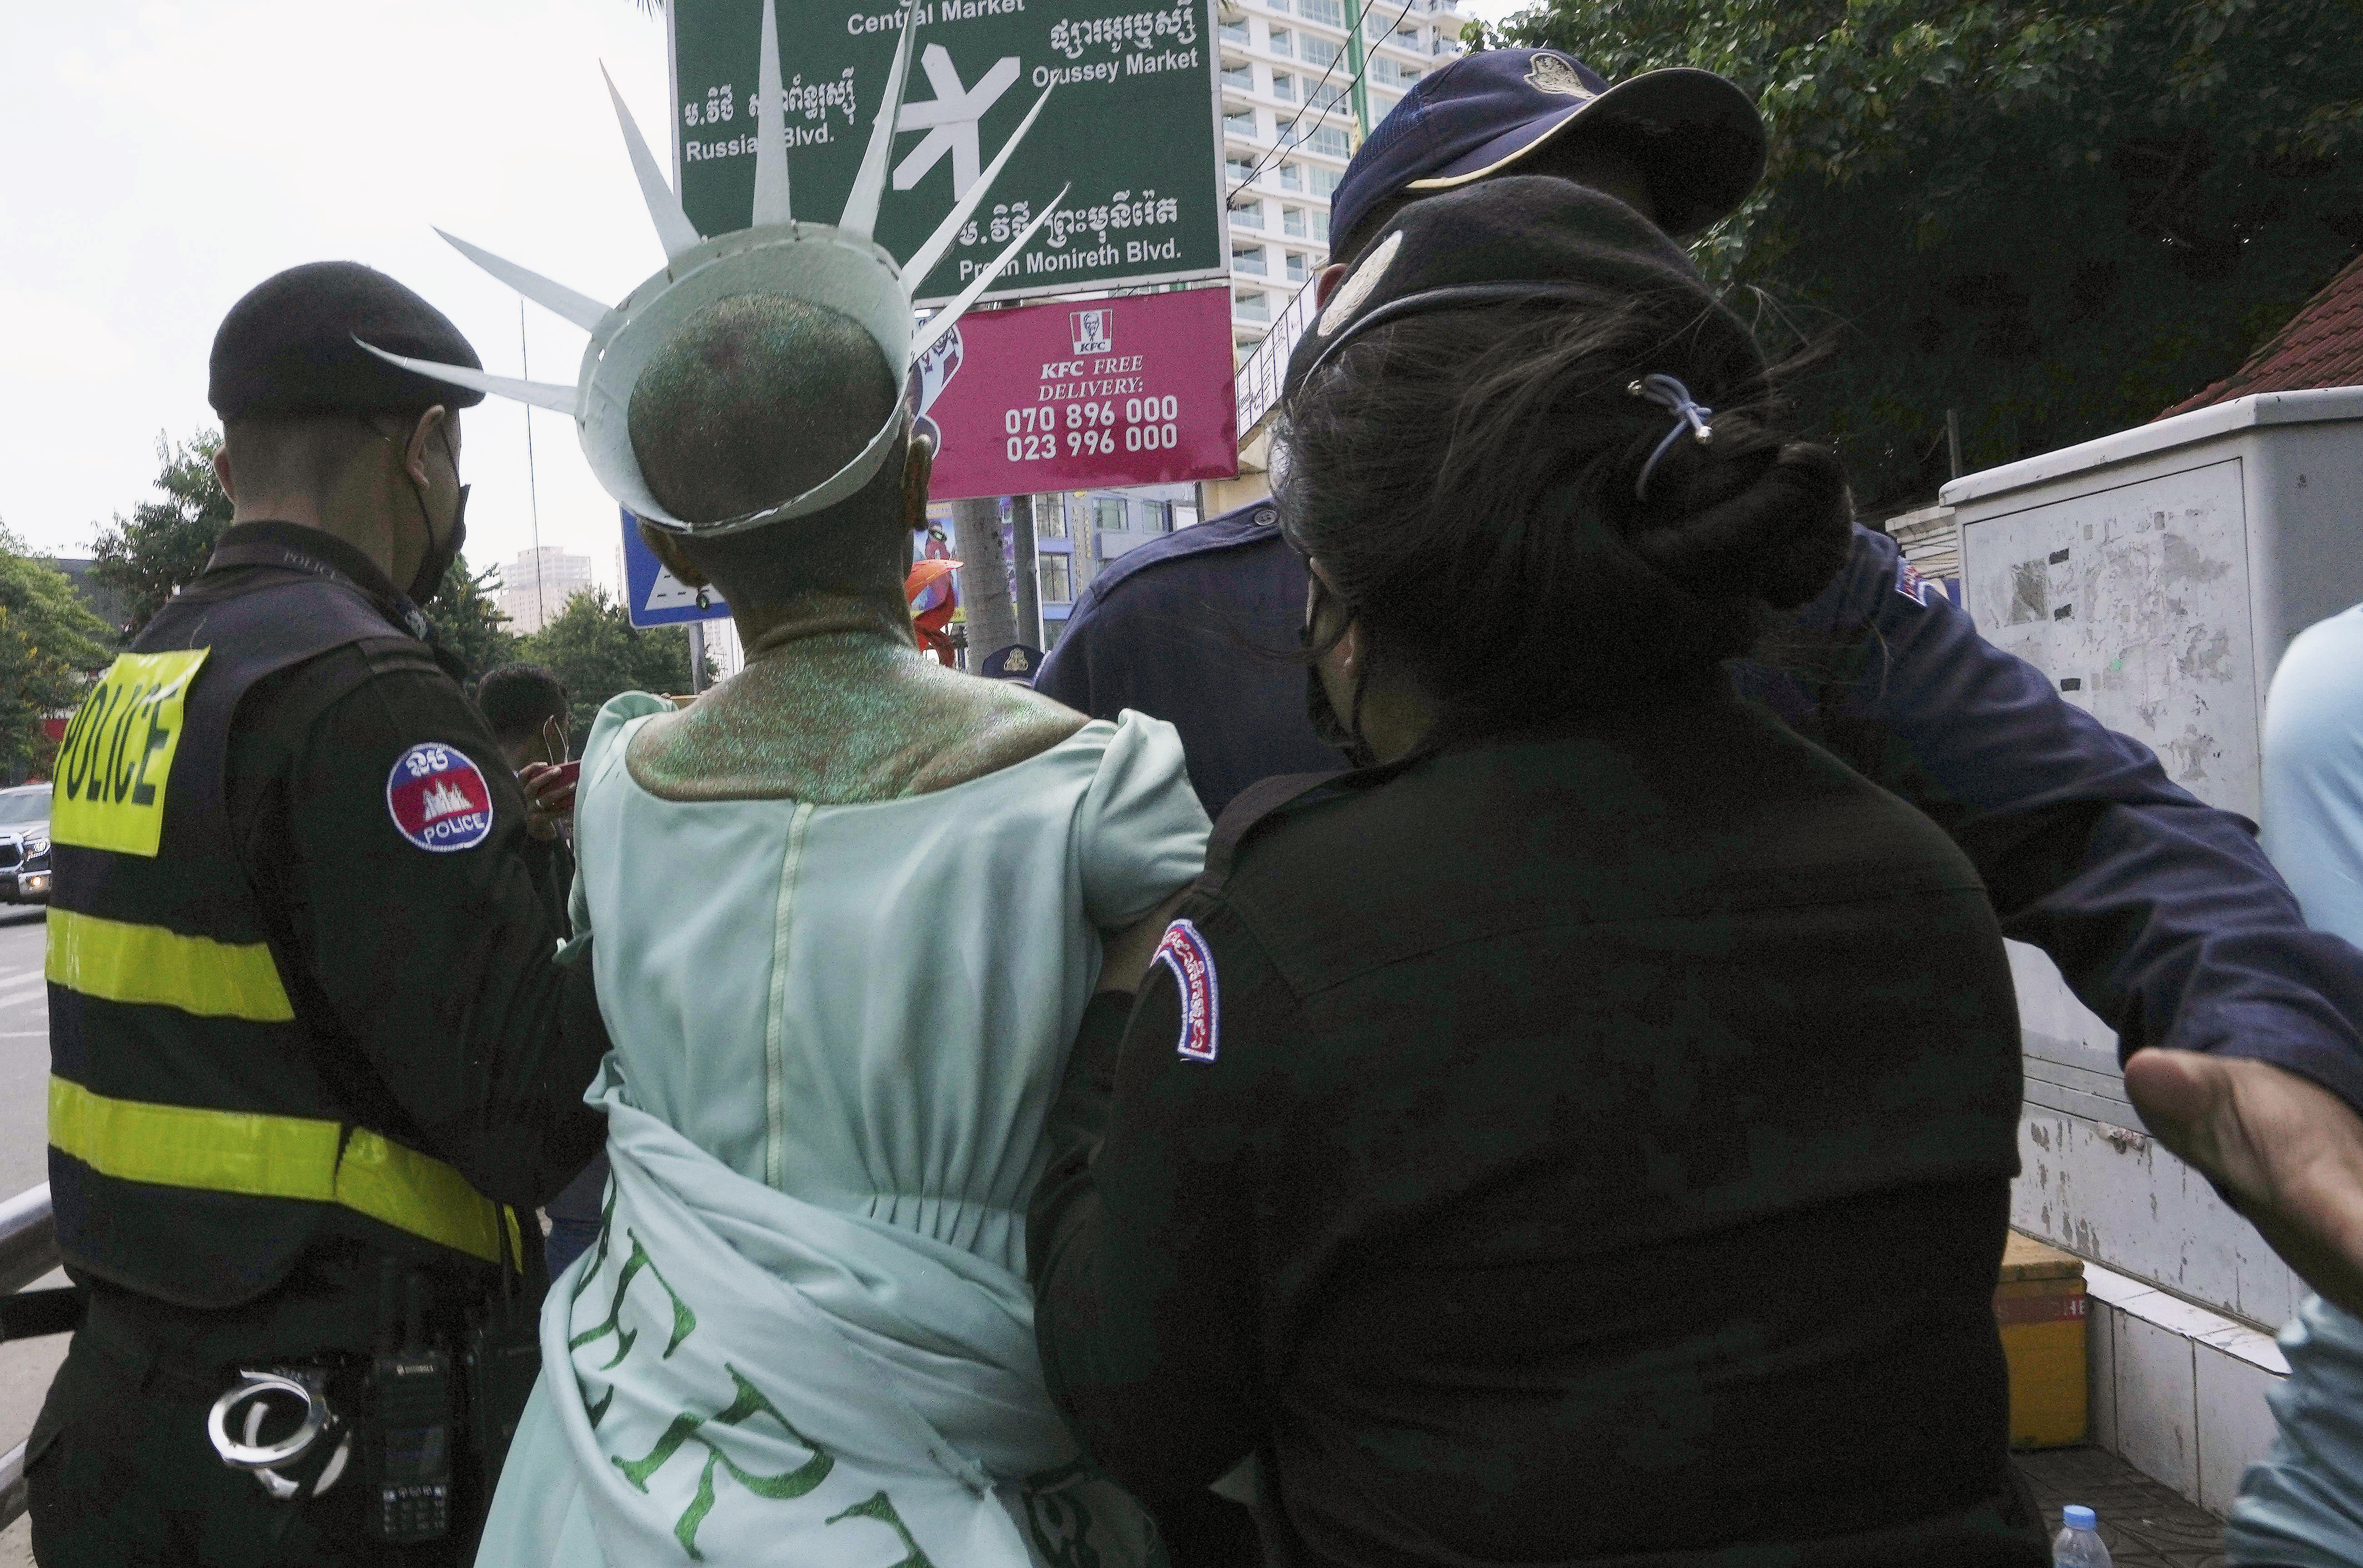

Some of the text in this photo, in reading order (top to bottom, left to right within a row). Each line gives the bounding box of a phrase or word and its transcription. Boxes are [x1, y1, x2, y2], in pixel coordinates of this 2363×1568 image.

[847, 0, 1026, 35] Cental Market
[1032, 47, 1198, 88] Orussey Market
[686, 123, 835, 162] Russia Blvd.
[1027, 244, 1120, 274] Monireth
[1127, 237, 1182, 263] Blvd.
[1080, 341, 1105, 353] KFC
[1040, 355, 1143, 380] KFC FREE
[1037, 377, 1144, 401] DELIVERY:
[1005, 394, 1178, 434] 070 896 000
[1007, 423, 1177, 462] 023 996 000
[52, 682, 180, 806] POLICE
[424, 812, 485, 844] POLICE
